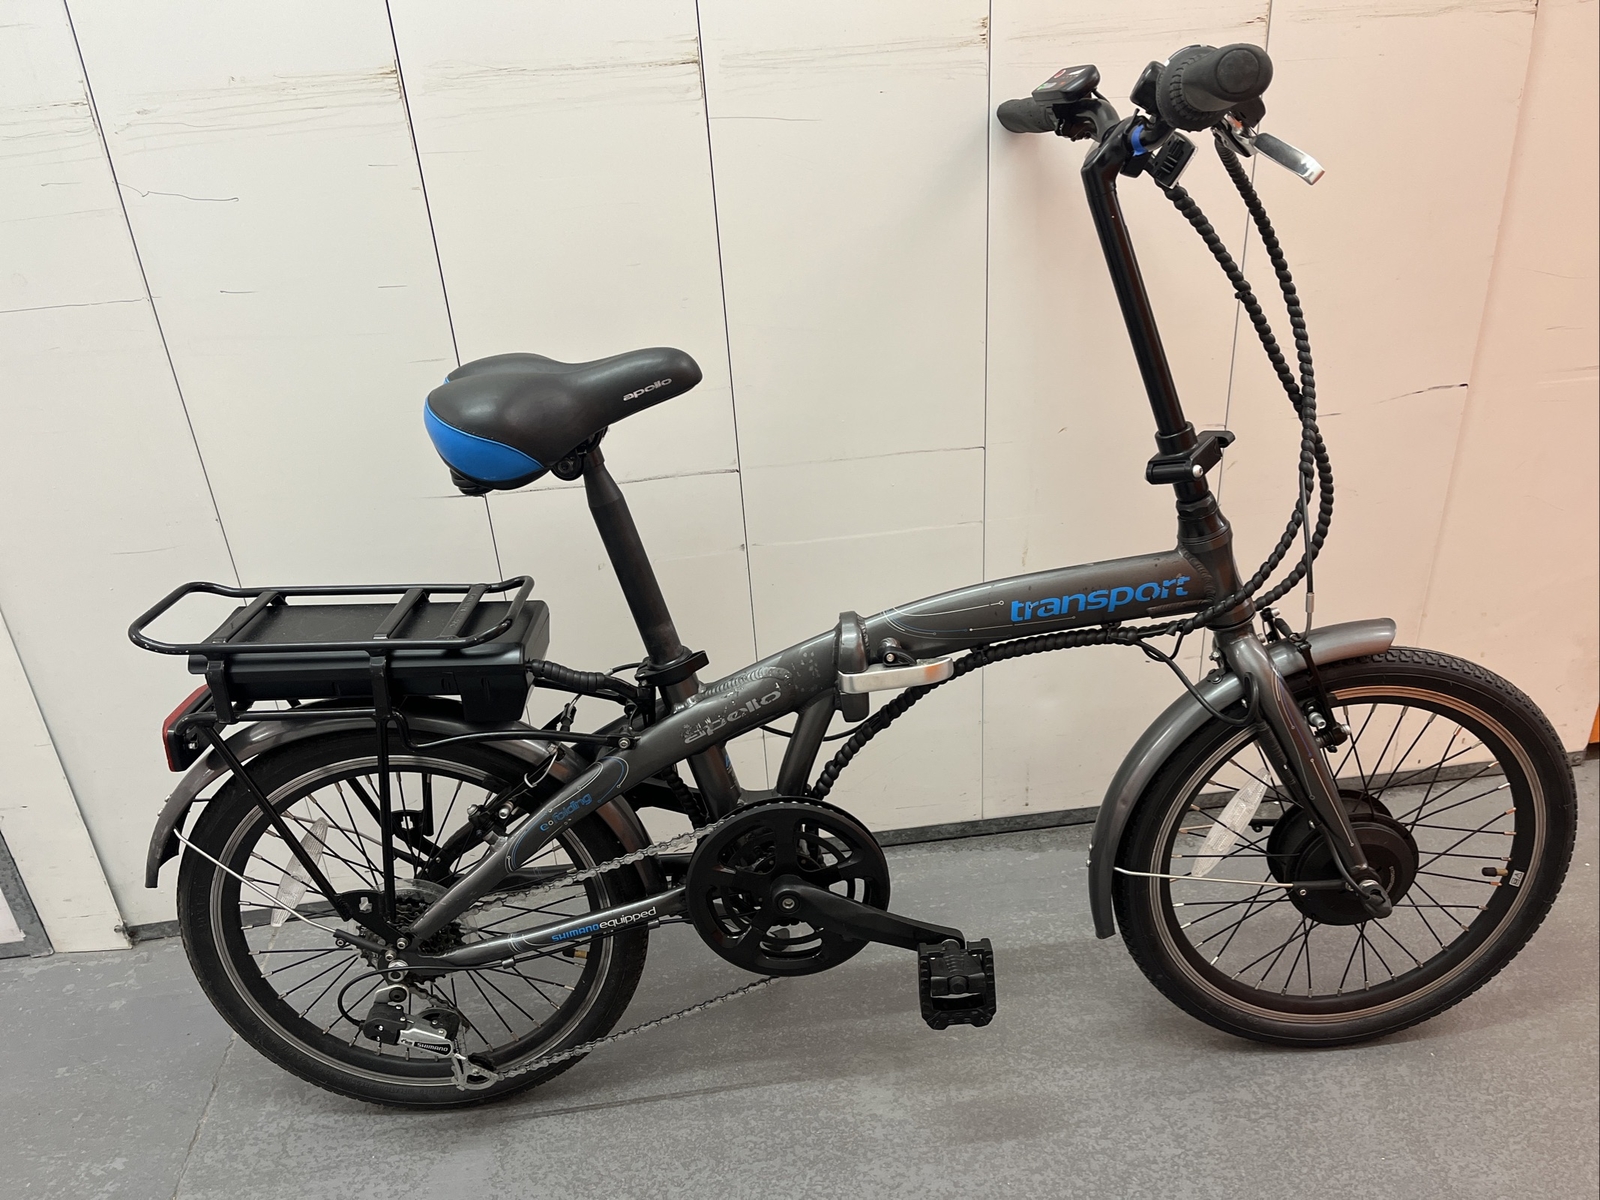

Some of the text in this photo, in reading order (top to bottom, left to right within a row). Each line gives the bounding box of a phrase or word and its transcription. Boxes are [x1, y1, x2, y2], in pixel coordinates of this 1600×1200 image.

[623, 378, 672, 401] apollo
[1010, 575, 1191, 622] transport
[417, 1042, 449, 1052] SHIMANO
